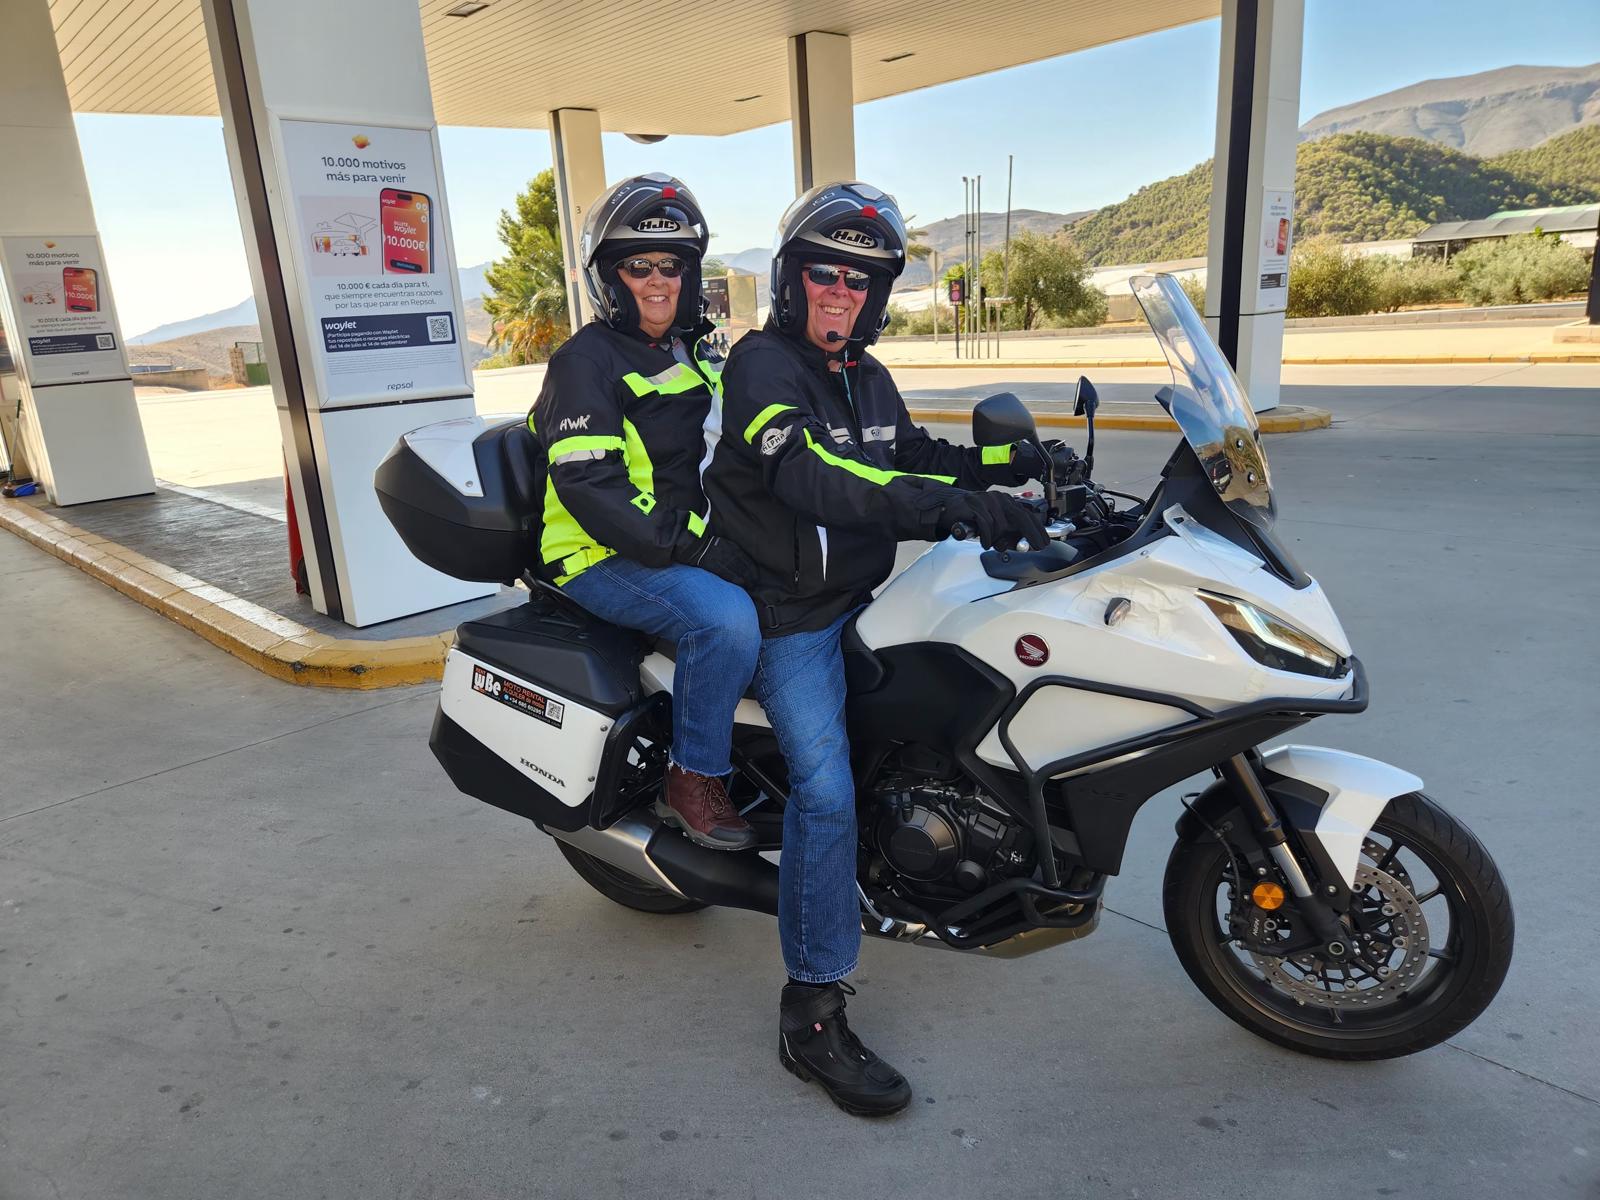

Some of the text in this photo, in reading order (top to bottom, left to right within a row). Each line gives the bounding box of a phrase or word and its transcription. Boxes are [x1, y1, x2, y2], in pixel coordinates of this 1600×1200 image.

[322, 156, 406, 170] 10.000 motivos
[326, 172, 406, 184] más para venir
[640, 220, 675, 230] HJC
[387, 236, 426, 250] 10.000€
[833, 230, 873, 246] HJC
[374, 290, 414, 298] encuentras
[325, 321, 356, 331] waylet
[387, 381, 413, 391] repsol
[504, 680, 545, 702] MOTO RENTAL
[520, 757, 566, 788] HONDA
